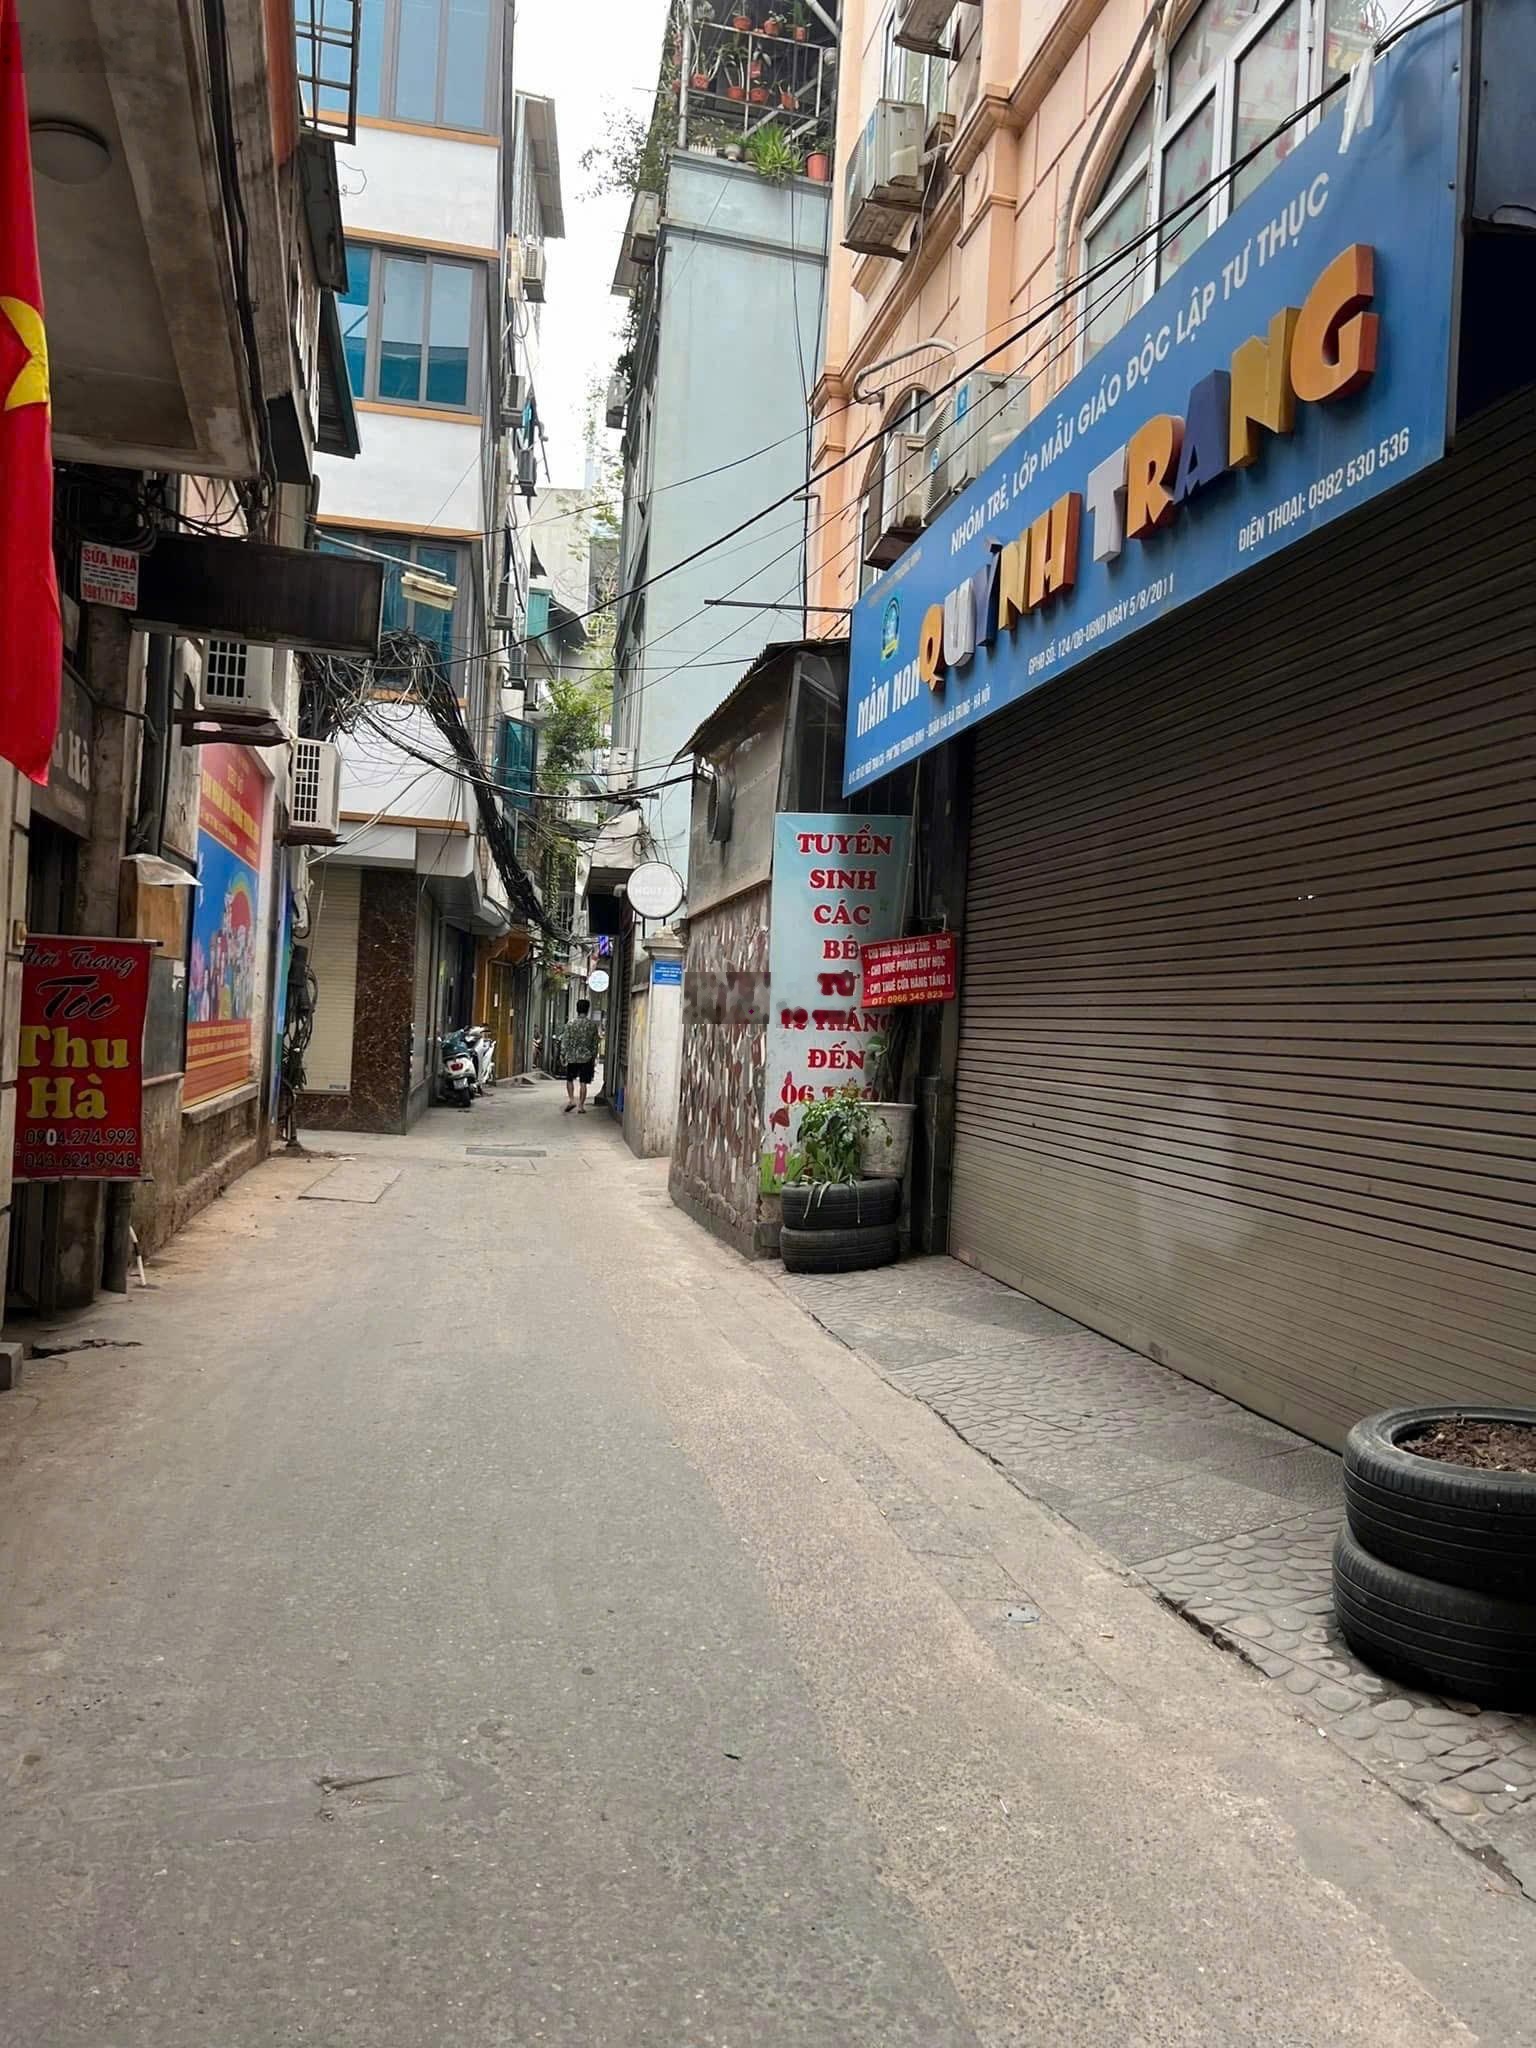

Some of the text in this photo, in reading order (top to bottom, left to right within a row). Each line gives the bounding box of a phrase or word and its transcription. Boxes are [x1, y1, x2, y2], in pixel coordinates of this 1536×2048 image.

[951, 506, 984, 554] NHÓM
[1013, 454, 1038, 501] LỚP
[1041, 414, 1074, 475] MẪU
[1077, 366, 1122, 434] GIÁO
[1126, 325, 1171, 392] ĐỘC
[1176, 281, 1216, 345] LẬP
[1222, 238, 1253, 301] TƯ
[1257, 172, 1330, 267] THỤC
[919, 244, 1377, 692] QUỲNH TRANG
[1239, 427, 1410, 552] ĐIỆN THOẠI: 0982 530 536
[1106, 599, 1129, 630] NGÀY
[1129, 573, 1174, 616] 5/8/2011
[857, 657, 920, 737] MẦM NON
[796, 824, 893, 855] TUYỂN
[809, 869, 877, 892] SINH
[813, 899, 871, 926] CÁC
[68, 946, 137, 979] Trang
[823, 935, 859, 961] BÉ
[36, 975, 120, 1021] Tóc
[910, 991, 925, 1001] 345
[18, 1024, 129, 1069] Thu
[808, 1041, 866, 1070] ĐẾN
[26, 1073, 108, 1120] Hà
